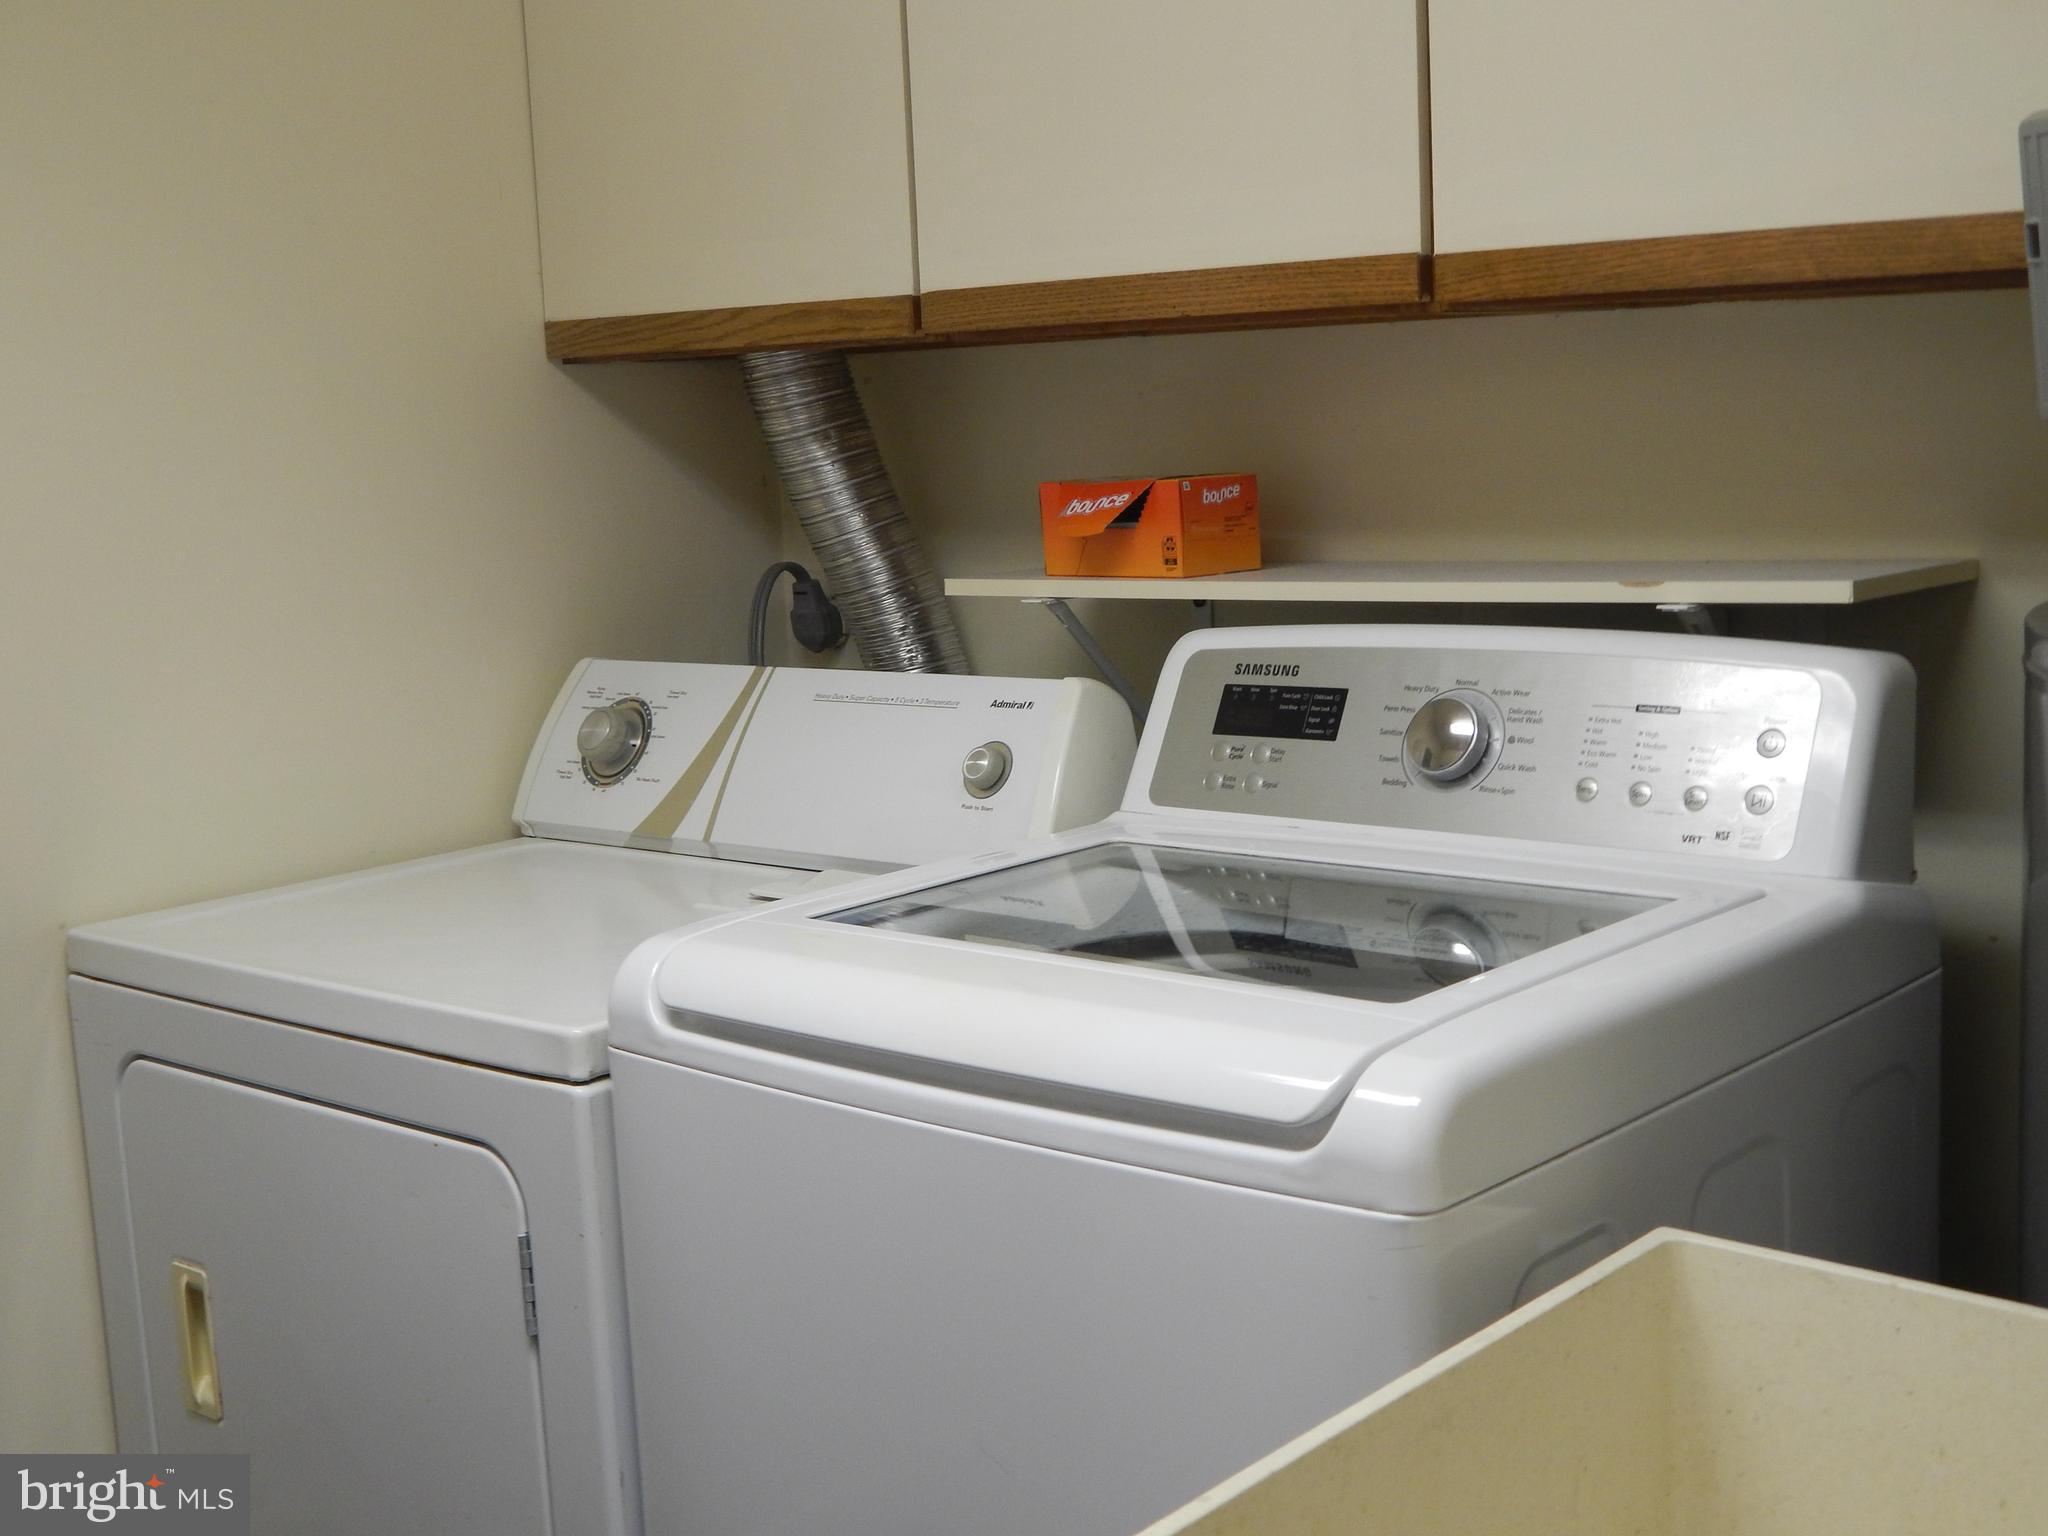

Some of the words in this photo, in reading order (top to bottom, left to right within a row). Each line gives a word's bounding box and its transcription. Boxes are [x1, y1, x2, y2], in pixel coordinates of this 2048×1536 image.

[1202, 484, 1240, 504] bounce
[1065, 493, 1131, 516] bounce
[1234, 662, 1300, 677] SAMSUNG
[1455, 679, 1479, 687] Normal
[1403, 685, 1423, 694] Heavy
[1424, 685, 1439, 693] Duty
[1491, 688, 1511, 696] Active
[1513, 689, 1531, 697] Wear
[925, 698, 960, 707] Temperature
[991, 700, 1026, 710] Admiral
[1516, 736, 1535, 744] Wool
[1498, 763, 1516, 771] Quick
[1518, 764, 1537, 772] Wash
[1382, 778, 1408, 788] Bedding
[1715, 831, 1731, 841] NSF
